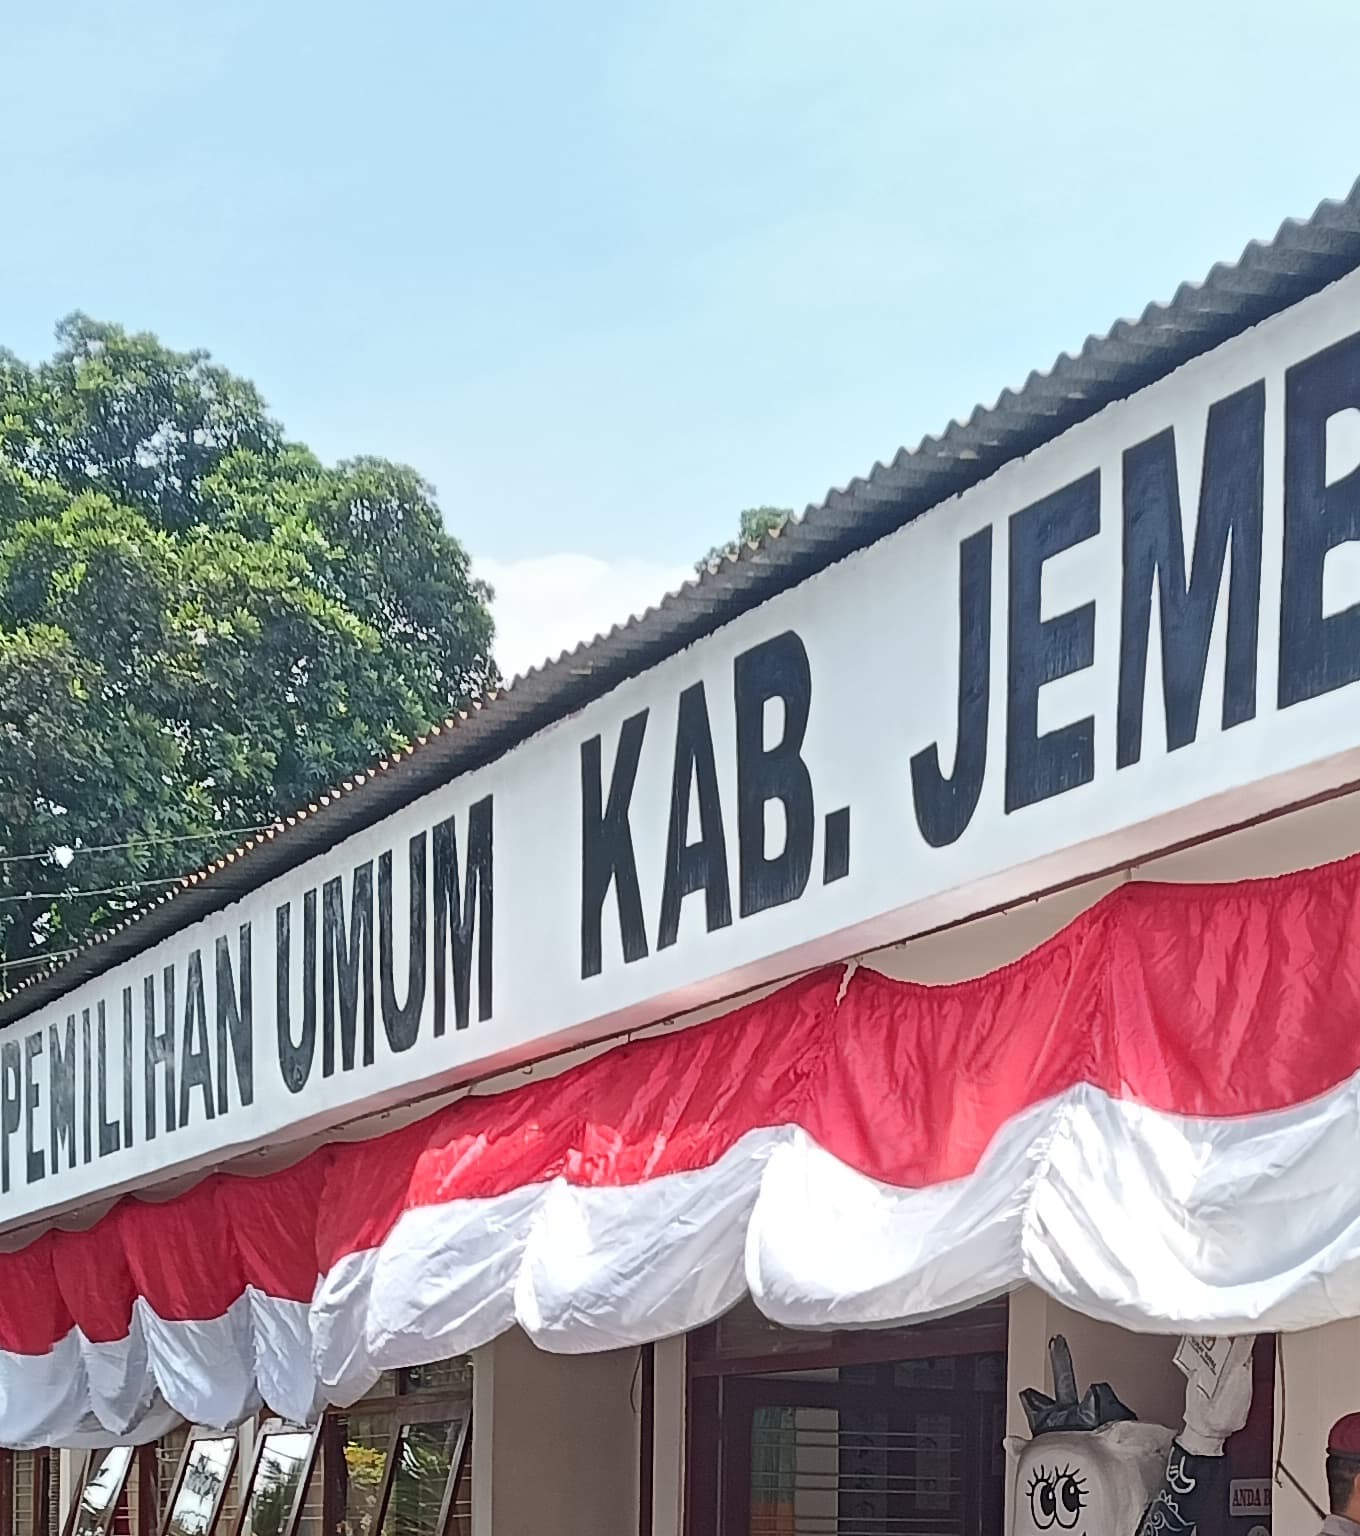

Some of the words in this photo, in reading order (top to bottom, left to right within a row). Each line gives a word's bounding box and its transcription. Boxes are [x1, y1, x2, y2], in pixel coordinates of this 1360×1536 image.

[0, 922, 253, 1195] PEMILIHAN
[275, 793, 493, 1095] UMUM
[580, 630, 851, 980] KAB.
[1232, 1488, 1261, 1507] ANDA
